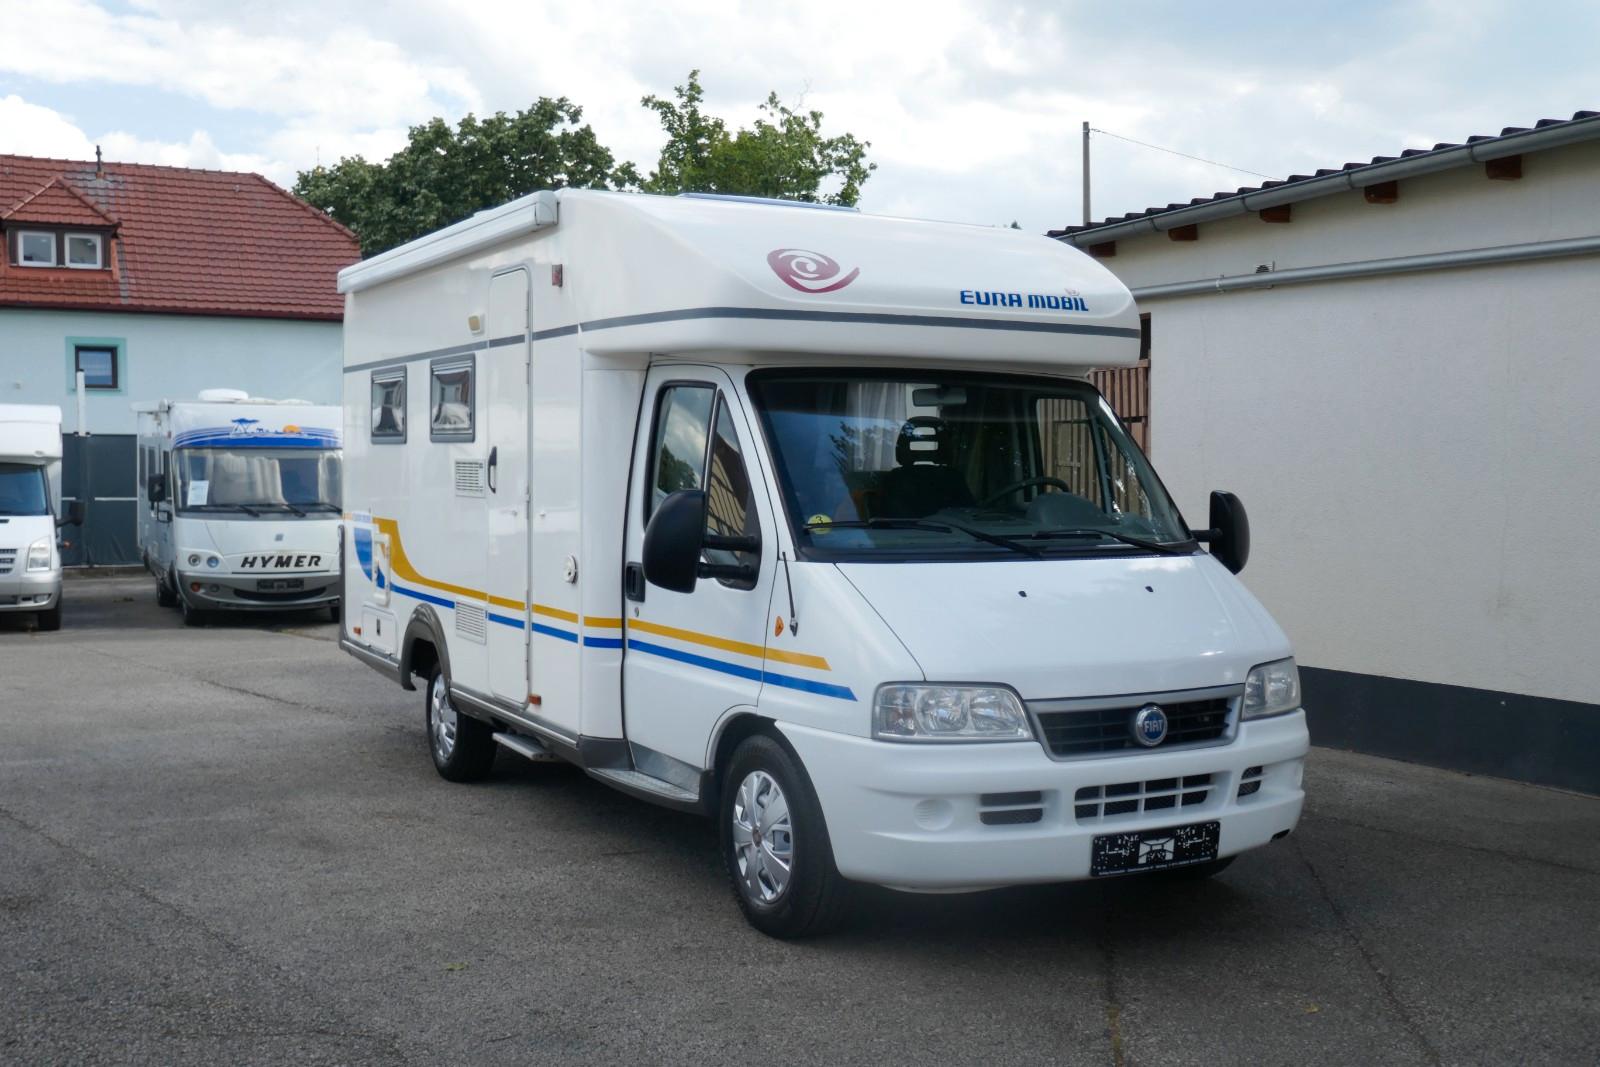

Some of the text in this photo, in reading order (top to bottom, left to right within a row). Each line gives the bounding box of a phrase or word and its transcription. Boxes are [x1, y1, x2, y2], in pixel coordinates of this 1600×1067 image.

[960, 290, 1089, 312] EURA MOBIL
[241, 555, 322, 569] HYMER
[1144, 719, 1164, 733] FIAT
